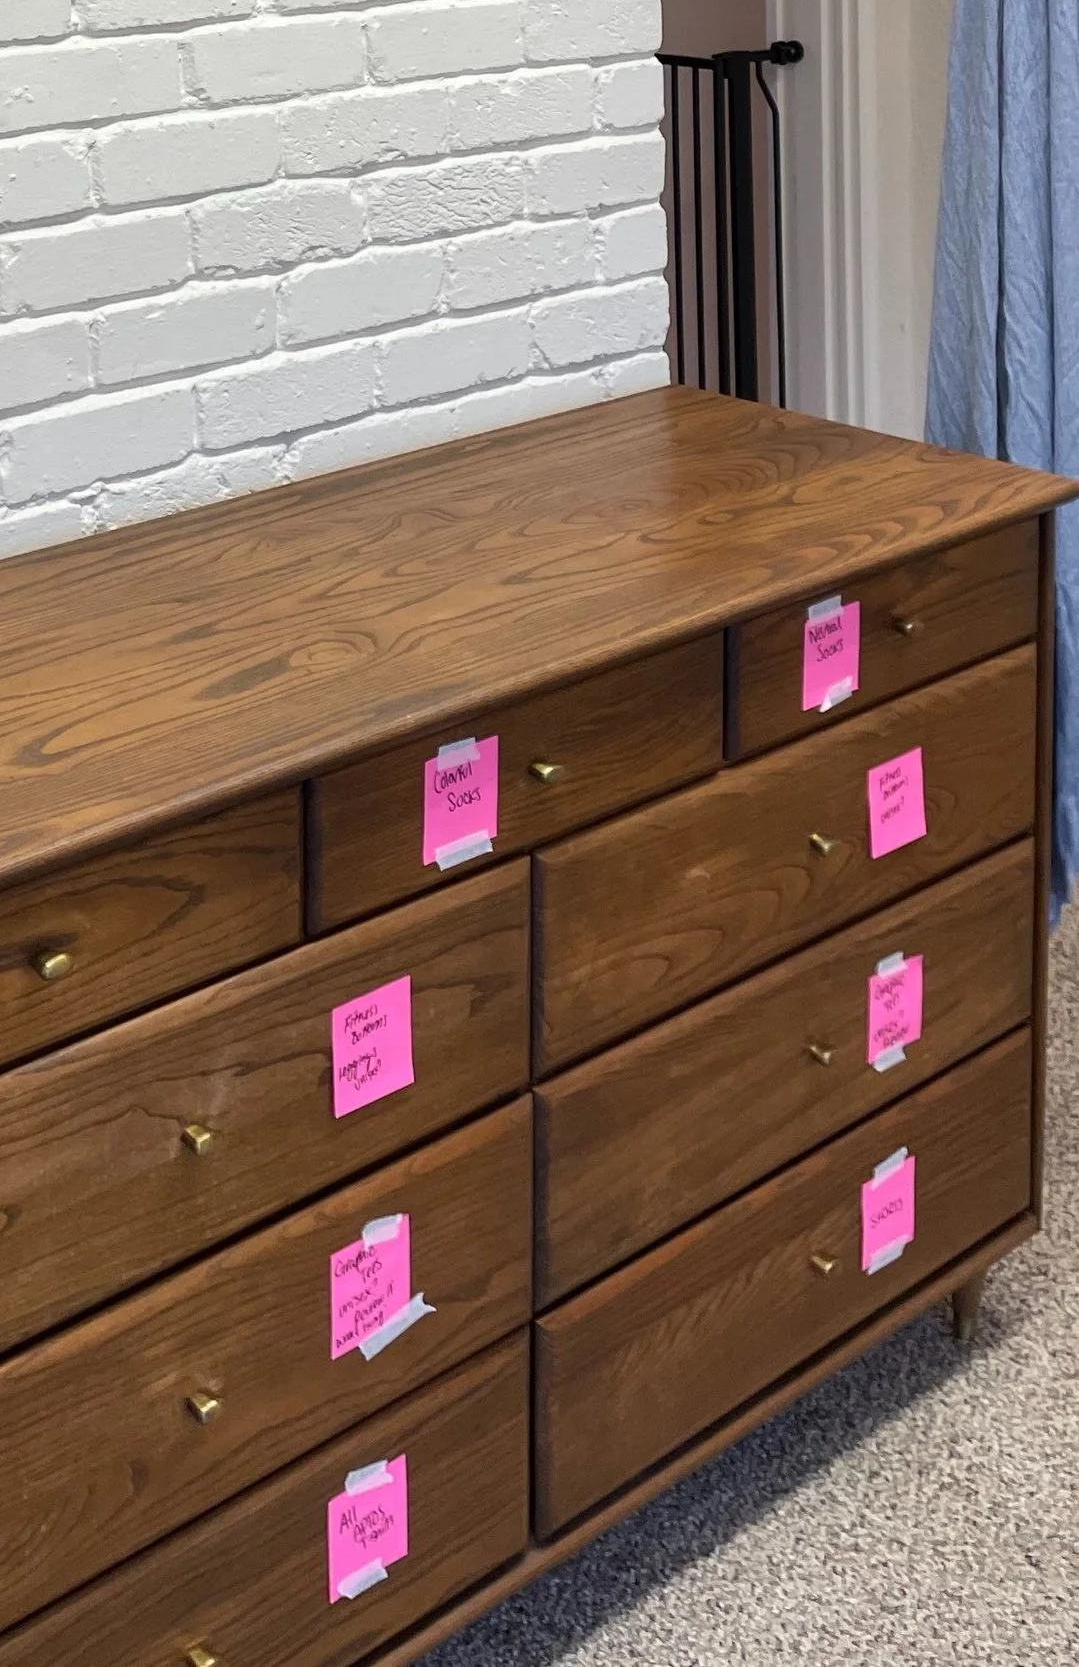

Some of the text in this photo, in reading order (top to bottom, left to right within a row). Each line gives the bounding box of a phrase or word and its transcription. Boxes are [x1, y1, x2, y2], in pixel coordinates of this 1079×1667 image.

[434, 761, 473, 794] Colorful
[447, 787, 481, 812] Socks
[344, 1005, 378, 1033] Fitness
[338, 1505, 357, 1534] All
